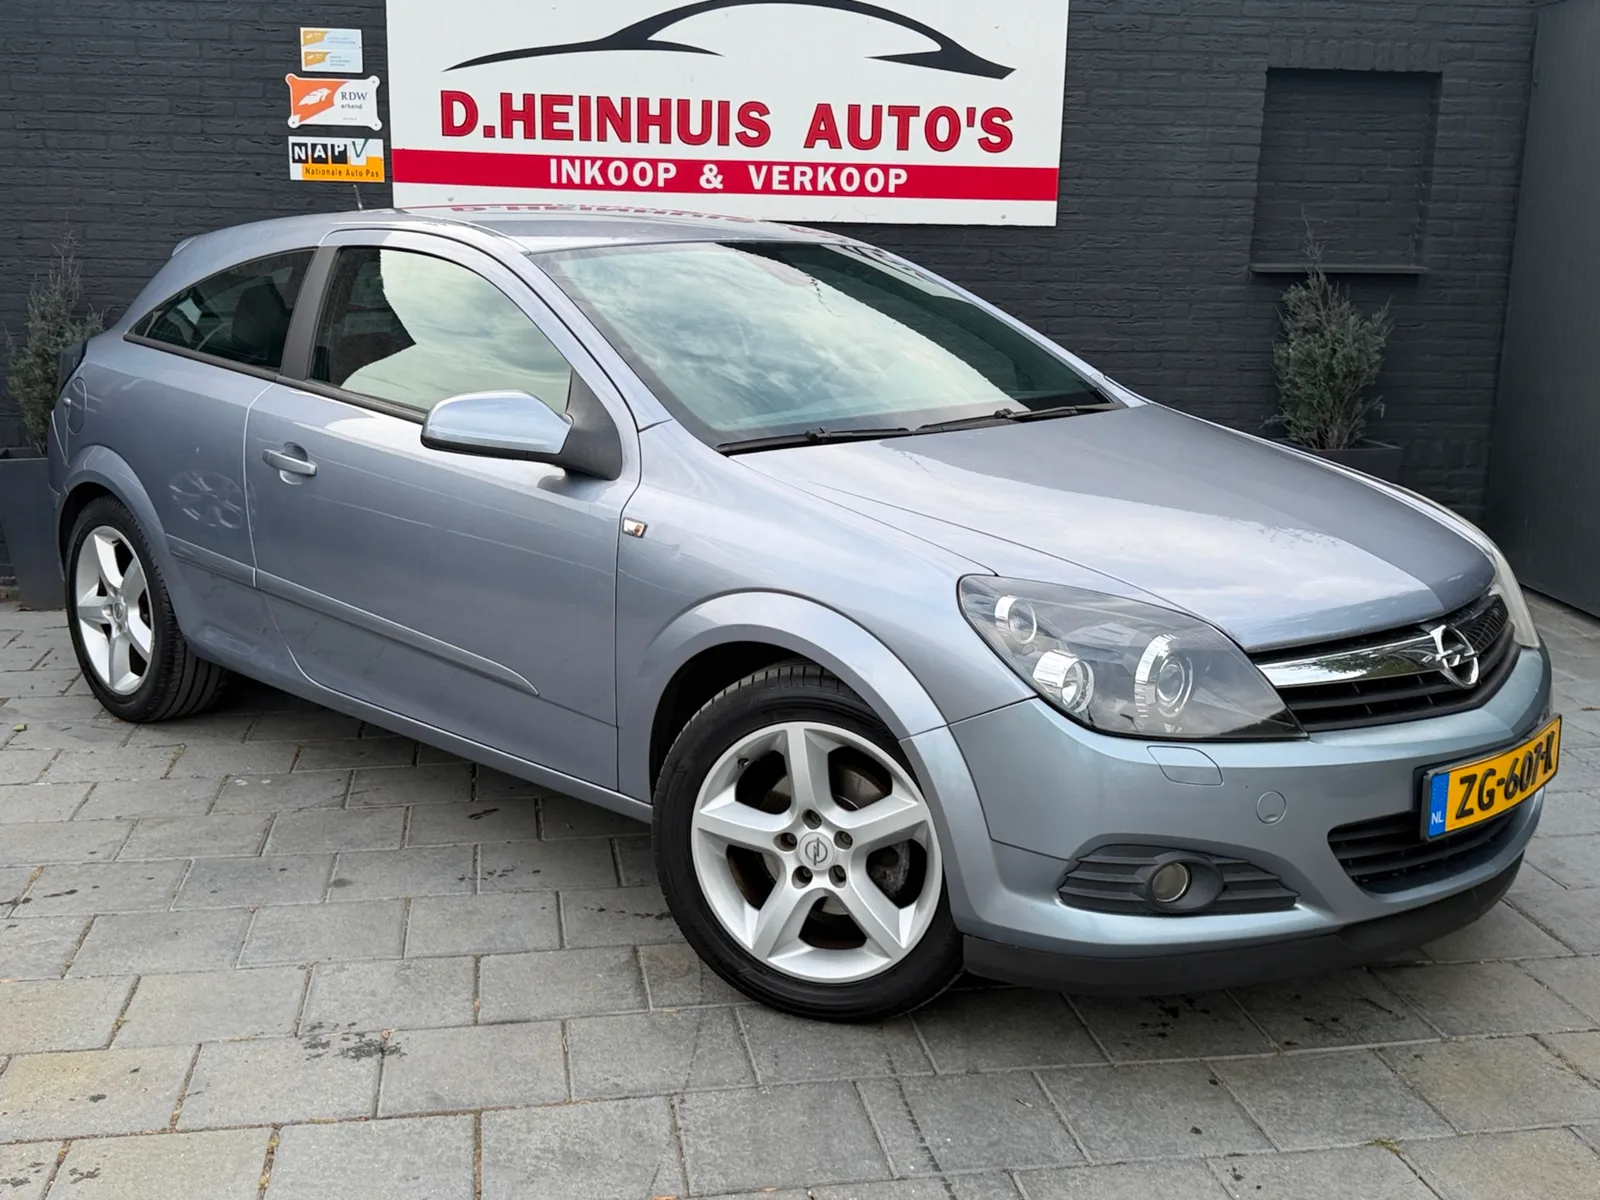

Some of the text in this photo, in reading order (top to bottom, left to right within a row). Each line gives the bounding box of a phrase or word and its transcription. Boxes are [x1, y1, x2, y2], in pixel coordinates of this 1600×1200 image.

[341, 92, 368, 101] RDW
[441, 90, 1013, 153] D.HEINHUIS AUTO'S
[305, 167, 379, 178] Nationale Auto Pas
[551, 159, 908, 193] INKOOP & VERKOOP
[1431, 810, 1444, 825] NL
